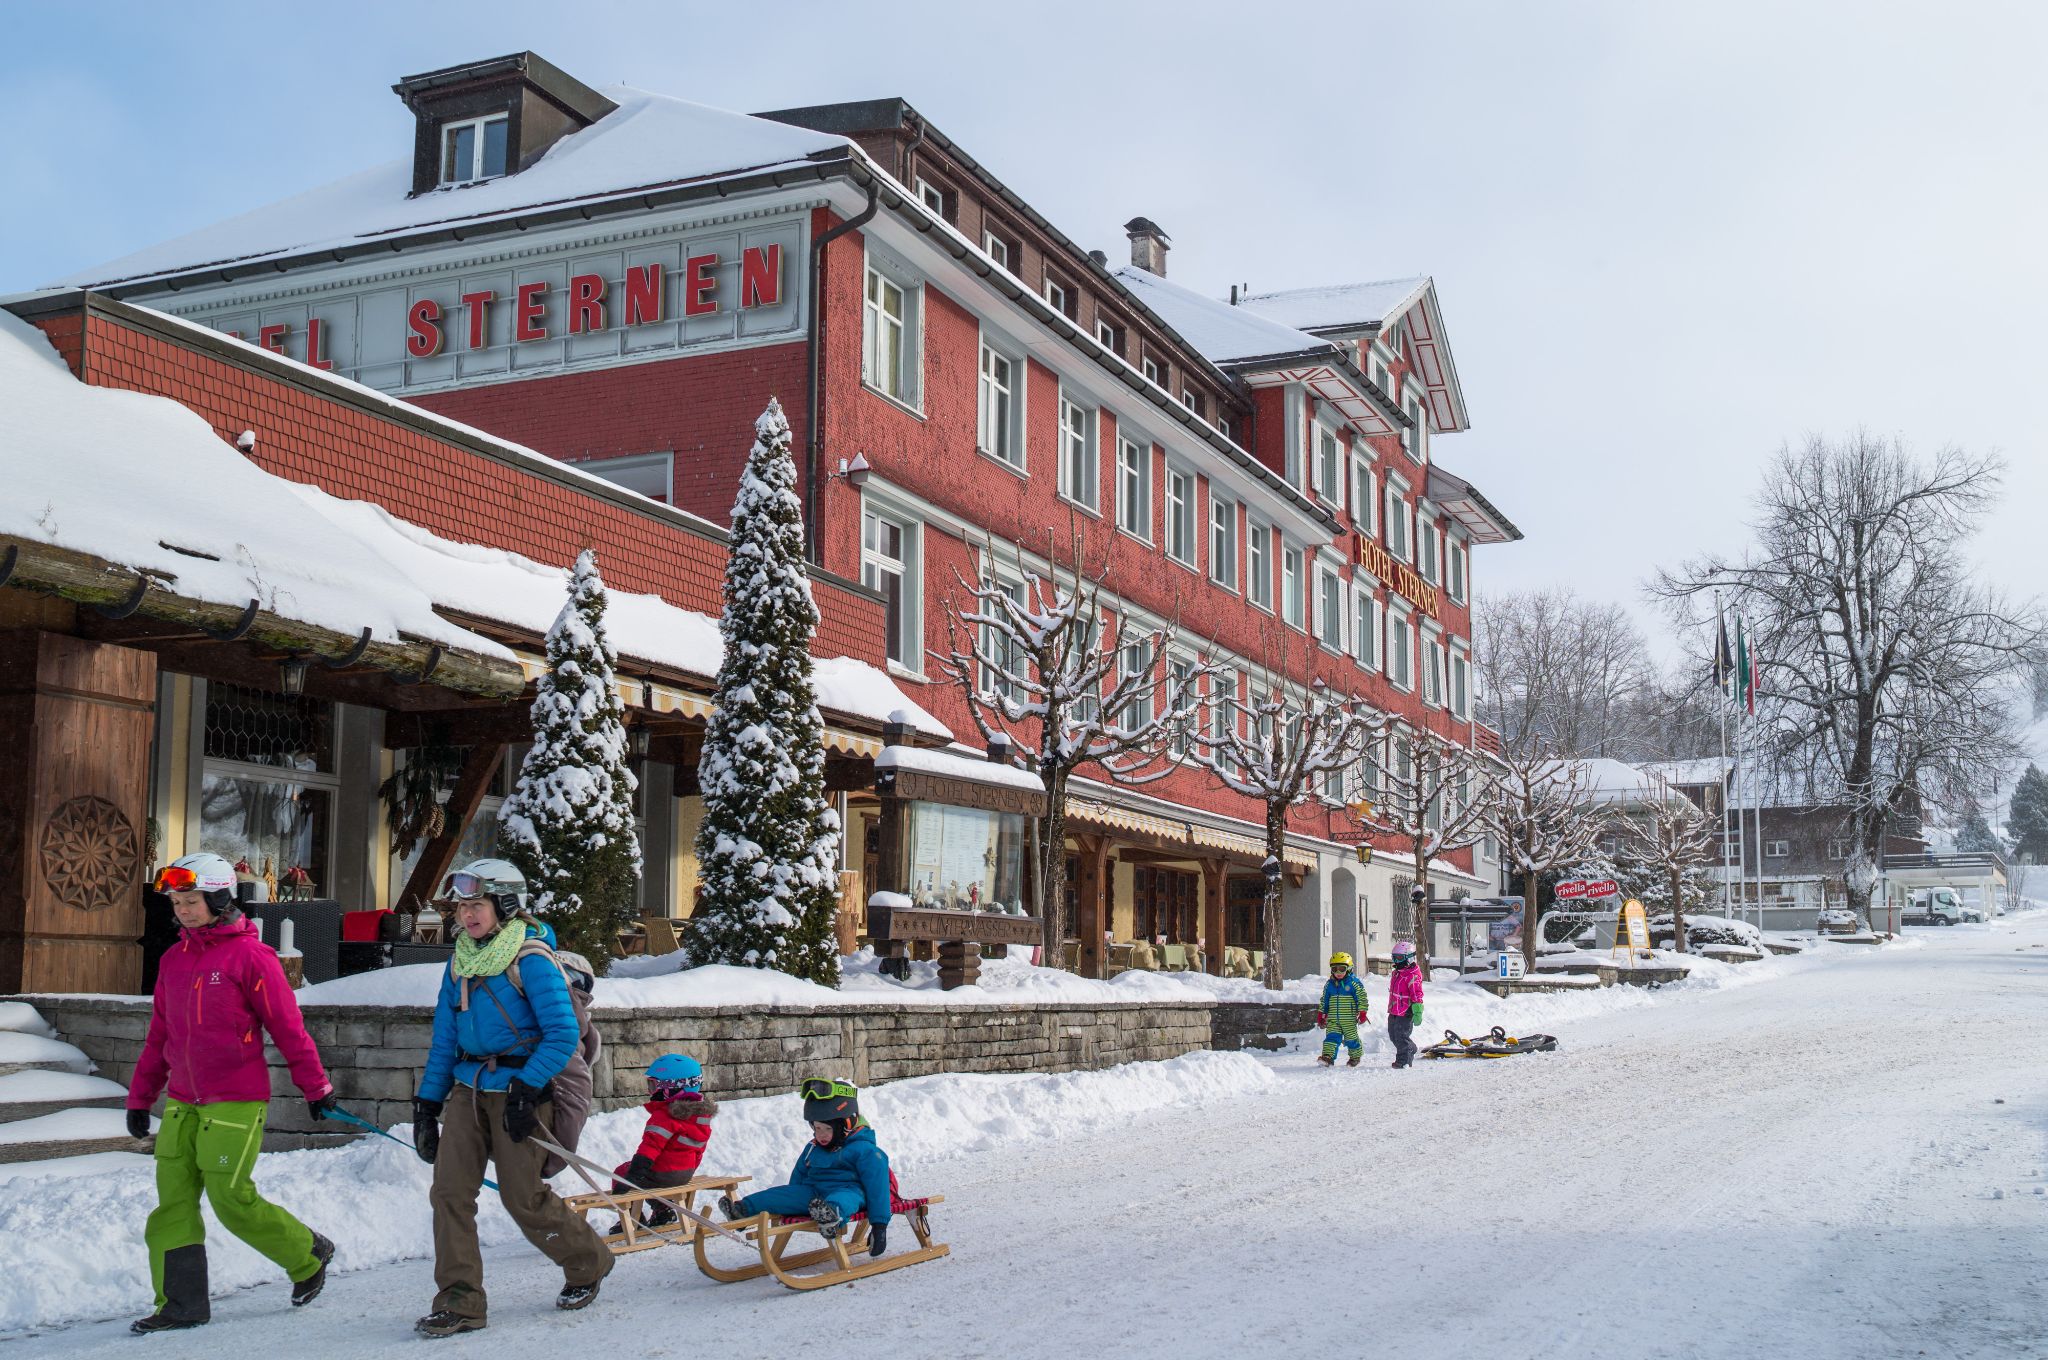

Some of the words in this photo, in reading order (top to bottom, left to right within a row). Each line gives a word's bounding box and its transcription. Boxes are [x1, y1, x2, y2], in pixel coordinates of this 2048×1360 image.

[407, 243, 784, 358] STERNEN
[1360, 534, 1394, 589] HOTEL
[1398, 563, 1439, 619] STERNEN
[926, 775, 966, 801] HOTEL
[971, 783, 1024, 809] STERNEN
[1558, 883, 1586, 896] rivella
[1587, 882, 1615, 896] rivella
[929, 915, 1011, 938] UNTERWASSER
